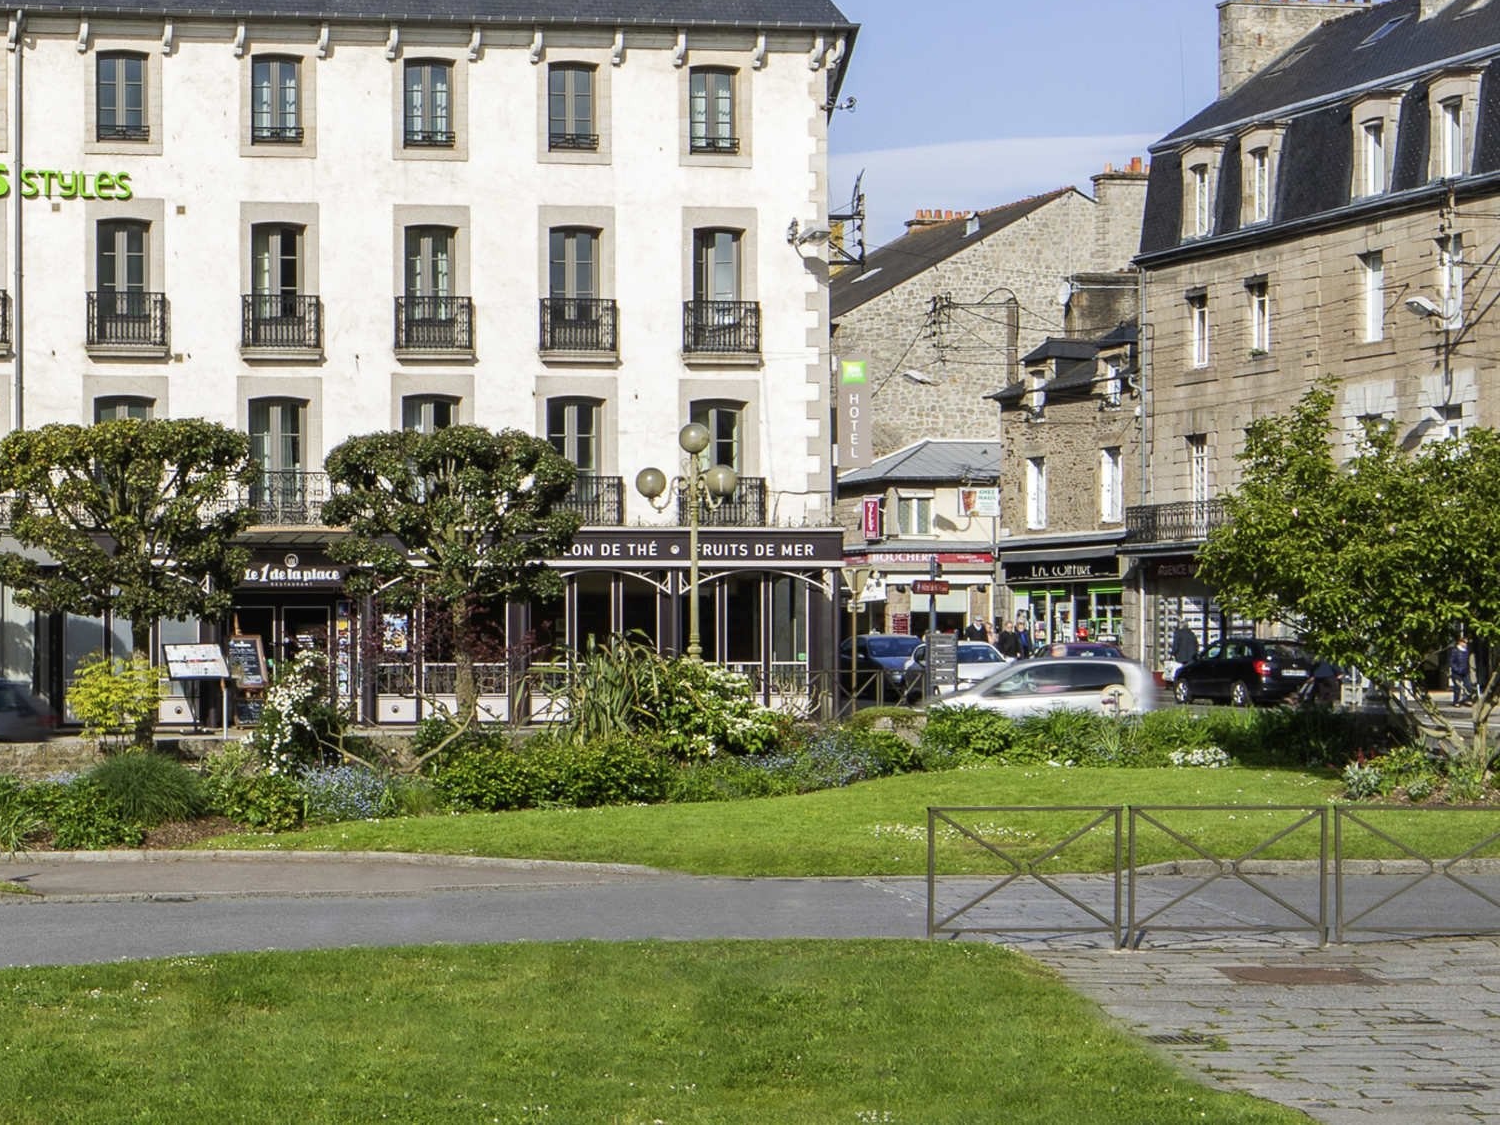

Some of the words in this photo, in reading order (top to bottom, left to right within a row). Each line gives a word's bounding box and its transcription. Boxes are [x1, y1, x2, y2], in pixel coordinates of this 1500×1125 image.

[849, 393, 859, 459] HOTEL
[600, 543, 621, 556] DE
[627, 540, 658, 556] THÉ
[755, 543, 775, 556] DE
[781, 543, 814, 556] MER
[259, 563, 270, 582] 1
[270, 568, 286, 581] de
[287, 568, 302, 581] la
[303, 568, 340, 582] place
